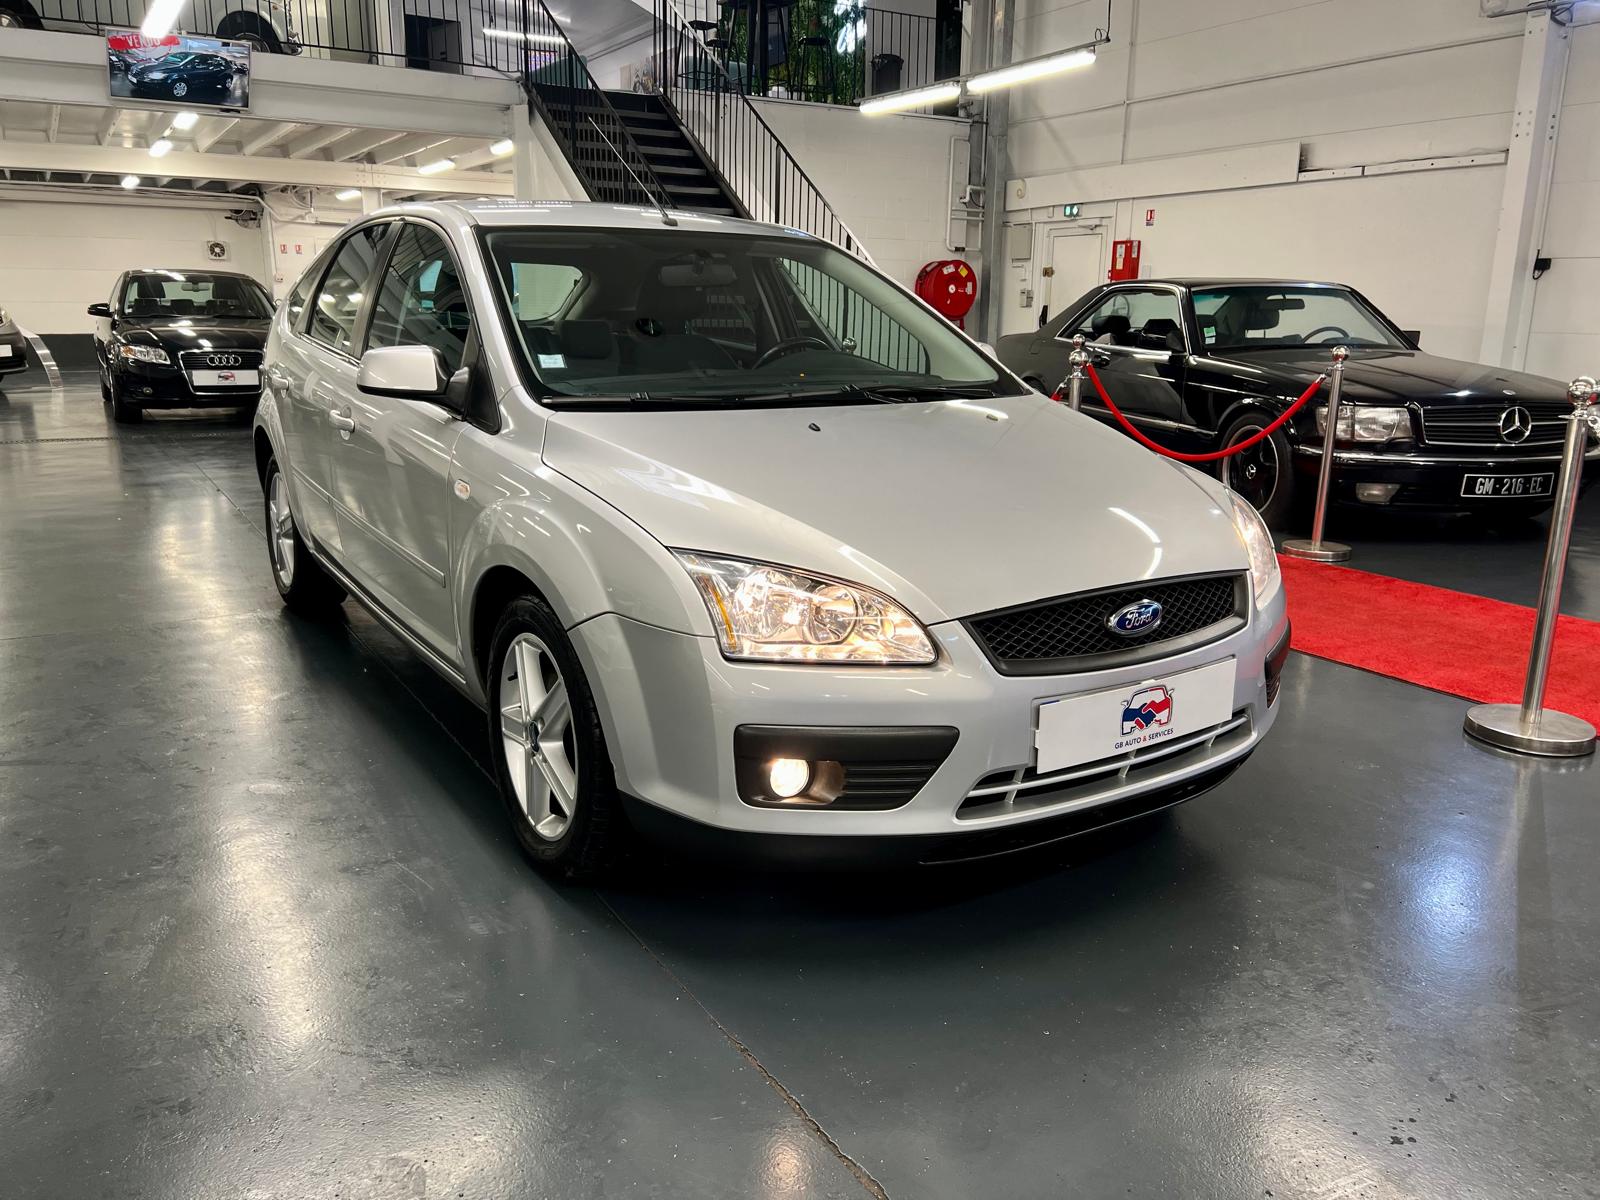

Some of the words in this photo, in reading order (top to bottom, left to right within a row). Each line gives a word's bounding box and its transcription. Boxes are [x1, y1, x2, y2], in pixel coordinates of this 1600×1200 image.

[1125, 606, 1155, 629] Ford
[1125, 737, 1142, 747] AUTO
[1148, 728, 1174, 741] SERVICES
